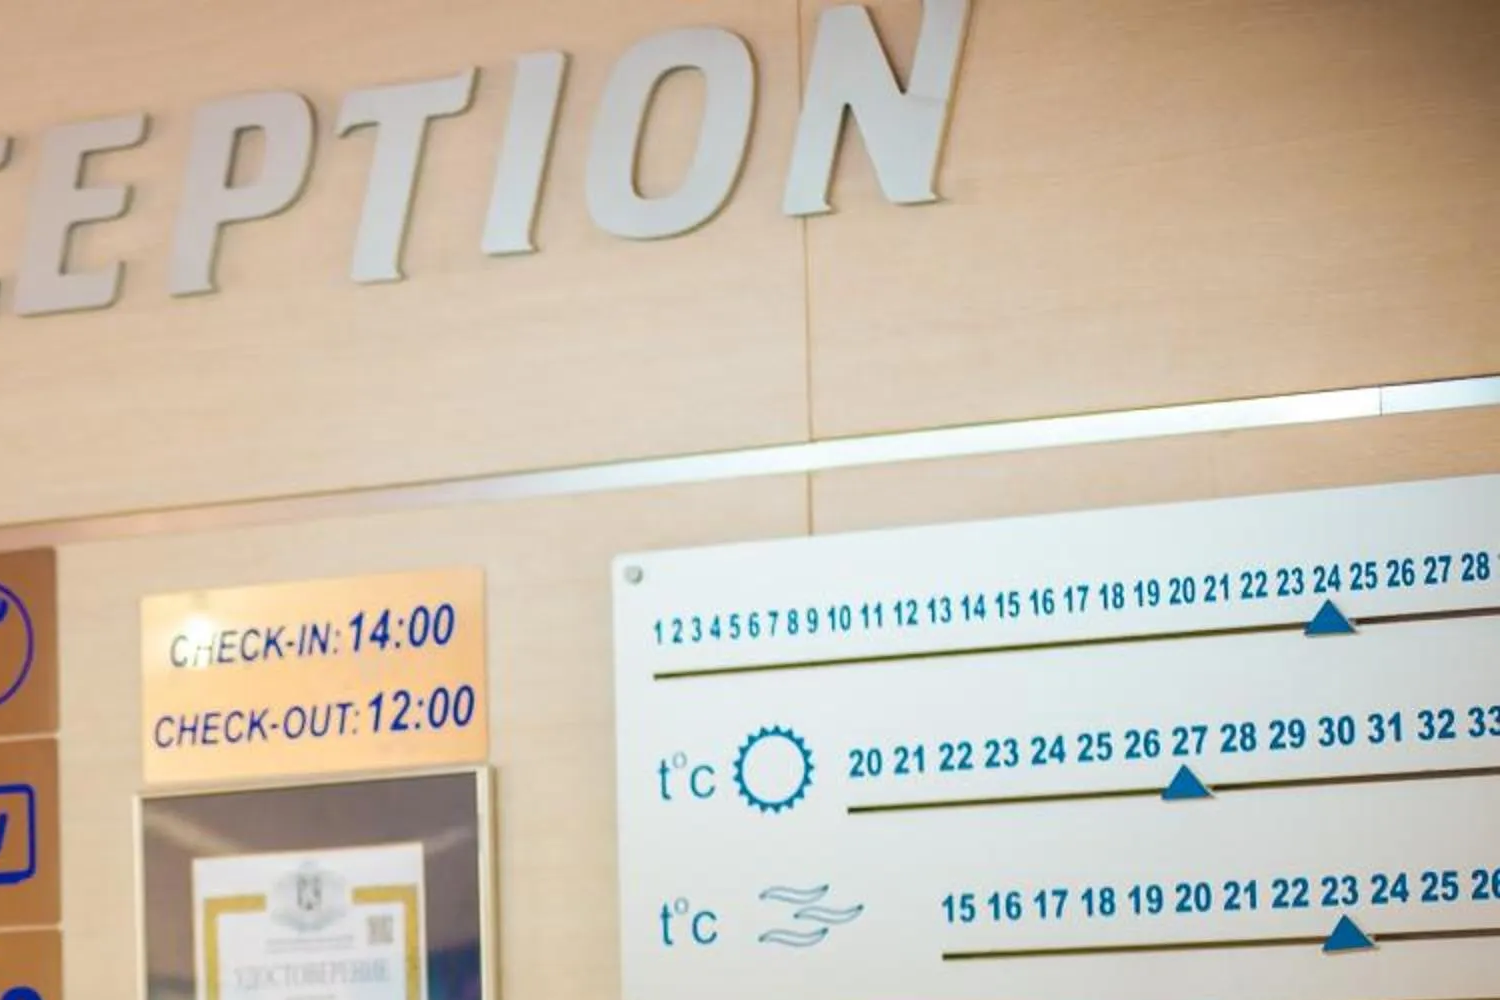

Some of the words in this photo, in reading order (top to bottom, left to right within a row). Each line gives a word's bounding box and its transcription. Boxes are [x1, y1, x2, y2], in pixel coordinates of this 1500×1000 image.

[349, 602, 456, 652] 14:00
[653, 619, 664, 645] 1
[670, 616, 684, 645] 2
[691, 614, 703, 644] 3
[708, 614, 723, 641] 4
[728, 612, 742, 641] 5
[746, 610, 762, 640] 6
[767, 608, 780, 637] 7
[786, 607, 800, 636] 8
[805, 606, 820, 635] 9
[826, 603, 853, 633] 10
[859, 600, 884, 630] 11
[892, 598, 919, 627] 12
[925, 594, 953, 625] 13
[959, 592, 988, 622] 14
[994, 589, 1021, 620] 15
[1028, 586, 1056, 617] 16
[1062, 583, 1091, 614] 17
[1098, 580, 1126, 611] 18
[1133, 577, 1162, 609] 19
[1168, 575, 1197, 606] 20
[1202, 572, 1230, 604] 21
[1239, 568, 1269, 601] 22
[1275, 566, 1306, 598] 23
[1312, 562, 1343, 595] 24
[1349, 560, 1379, 592] 25
[1385, 557, 1417, 589] 26
[1422, 554, 1453, 586] 27
[1460, 550, 1491, 583] 28
[153, 702, 361, 749] CHECK-OUT:
[367, 684, 476, 734] 12:00
[847, 746, 884, 780] 20
[892, 743, 926, 777] 21
[937, 739, 975, 773] 22
[983, 736, 1021, 770] 23
[1029, 733, 1067, 767] 24
[1076, 730, 1114, 764] 25
[1123, 727, 1162, 761] 26
[1171, 723, 1209, 757] 27
[1219, 721, 1258, 754] 28
[1268, 717, 1307, 752] 29
[1317, 714, 1357, 748] 30
[1367, 710, 1403, 745] 31
[1416, 707, 1458, 742] 32
[941, 892, 977, 925] 15
[986, 889, 1023, 922] 16
[1032, 887, 1070, 920] 17
[1080, 885, 1117, 919] 18
[1127, 883, 1165, 916] 19
[1174, 881, 1213, 914] 20
[1222, 879, 1258, 912] 21
[1271, 875, 1311, 910] 22
[1320, 874, 1360, 908] 23
[1369, 871, 1411, 906] 24
[1419, 869, 1461, 904] 25
